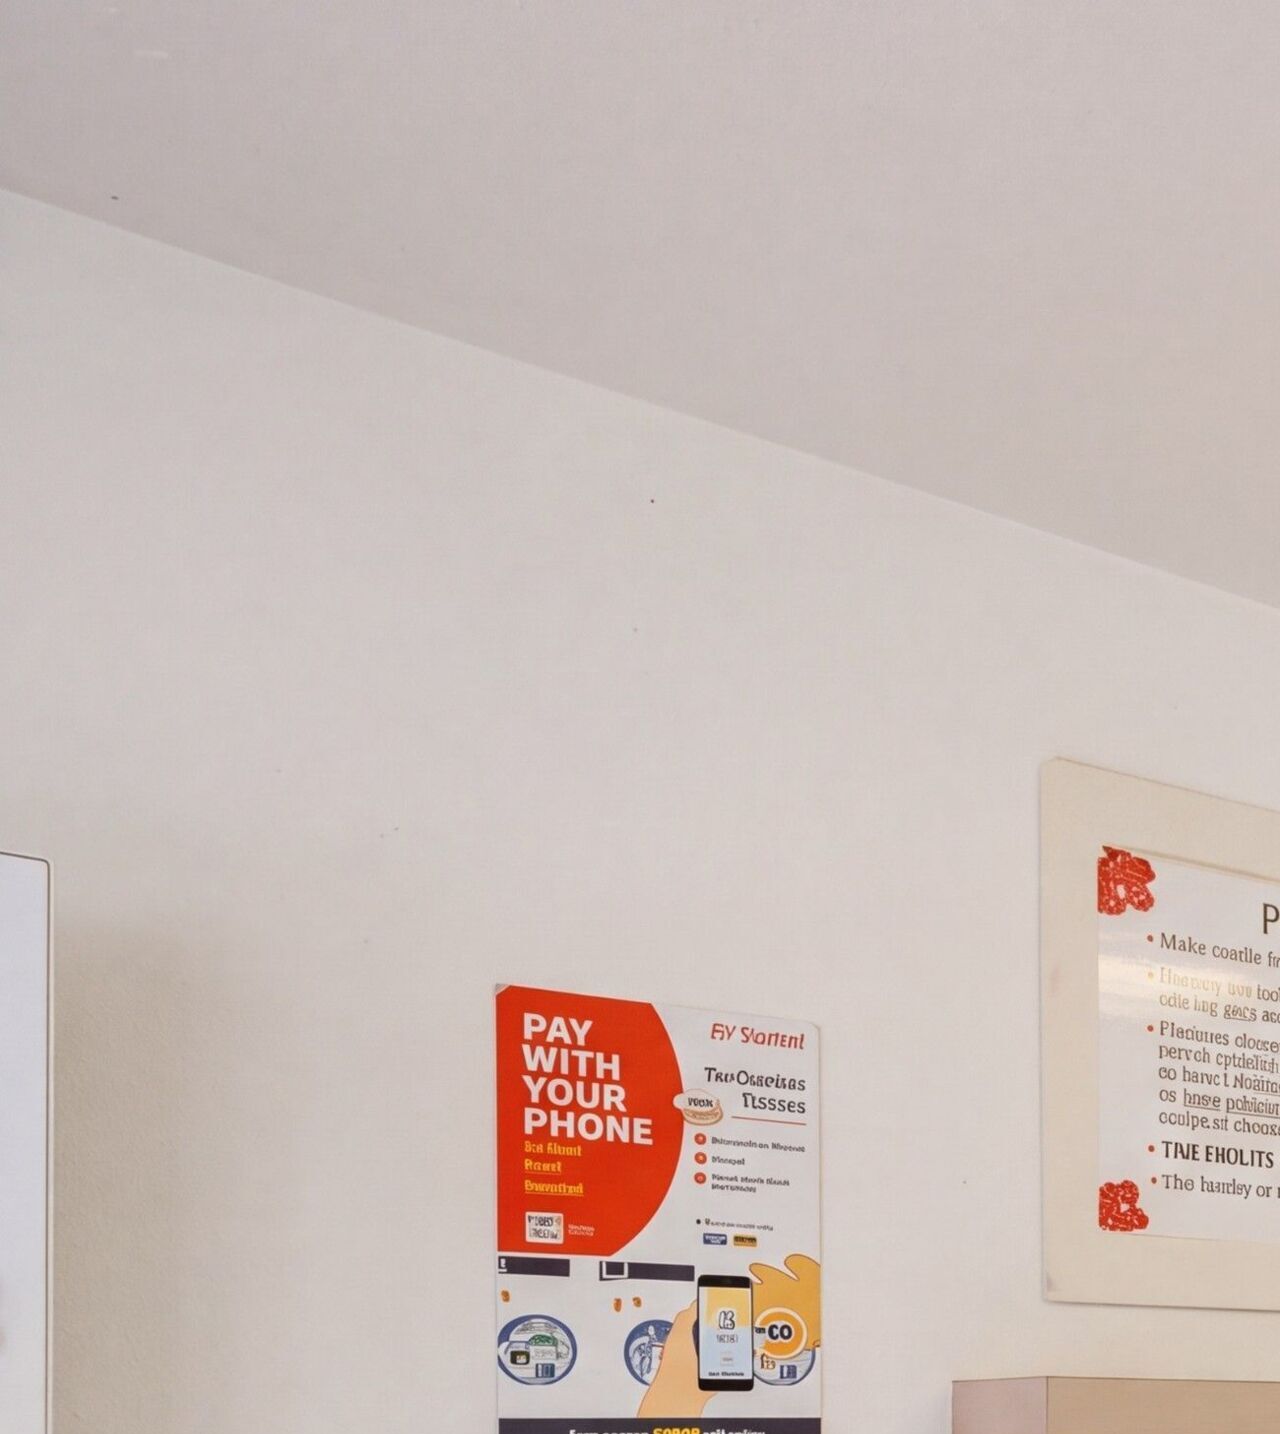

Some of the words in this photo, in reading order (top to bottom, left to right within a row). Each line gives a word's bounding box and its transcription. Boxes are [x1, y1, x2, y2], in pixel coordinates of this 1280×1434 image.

[1160, 932, 1206, 956] Make
[523, 1012, 593, 1046] PAY
[521, 1043, 621, 1081] WITH
[521, 1074, 628, 1113] YOUR
[524, 1107, 654, 1146] PHONE
